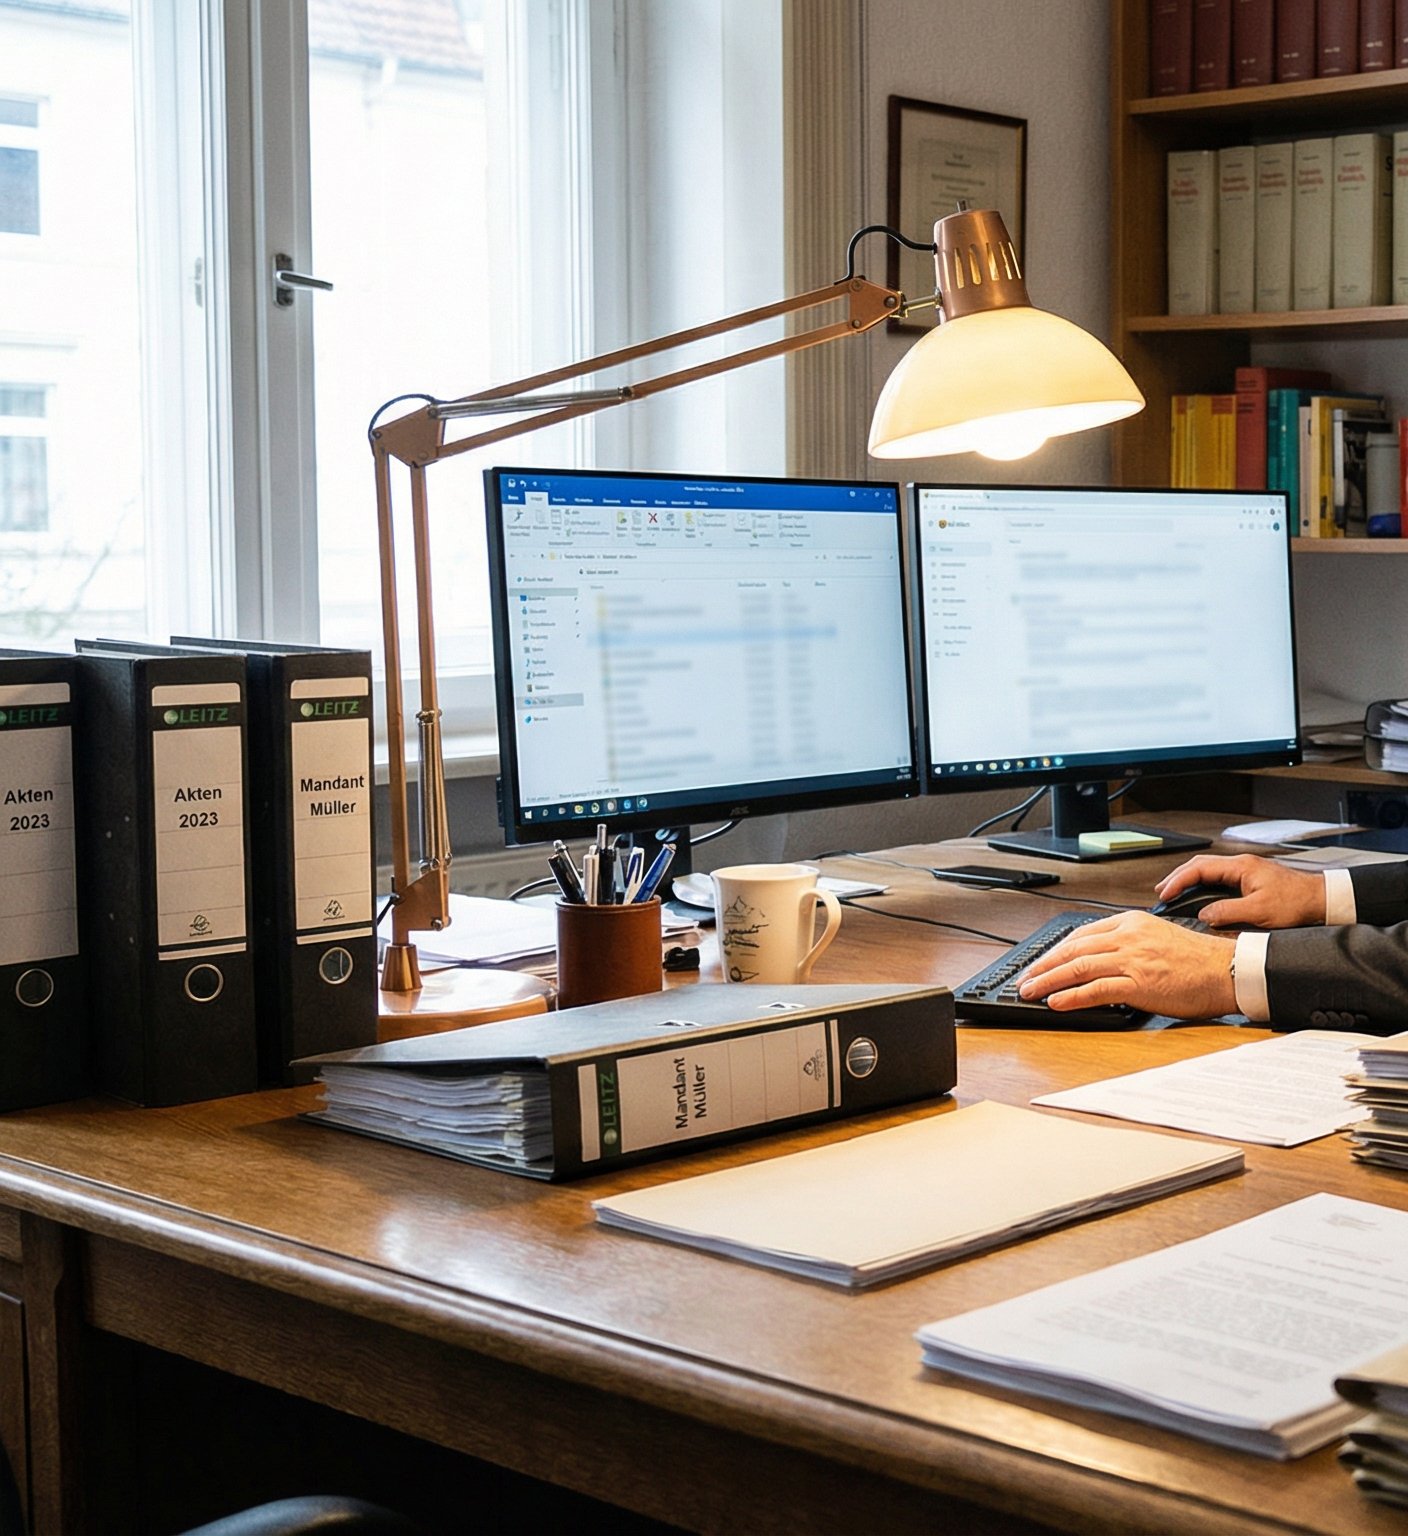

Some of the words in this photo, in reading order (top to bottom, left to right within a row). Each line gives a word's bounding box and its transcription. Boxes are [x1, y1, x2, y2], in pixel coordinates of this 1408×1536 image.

[8, 708, 59, 724] LEITZ
[179, 707, 229, 724] LEITZ
[315, 700, 360, 716] LEITZ
[300, 774, 365, 792] Mandant
[4, 789, 54, 805] Akten
[174, 787, 222, 803] Akten
[310, 800, 356, 817] Müller
[10, 813, 50, 831] 2023
[179, 811, 219, 828] 2023
[600, 1072, 617, 1127] LEITZ
[672, 1056, 688, 1130] Mandant
[693, 1064, 707, 1119] Müller
